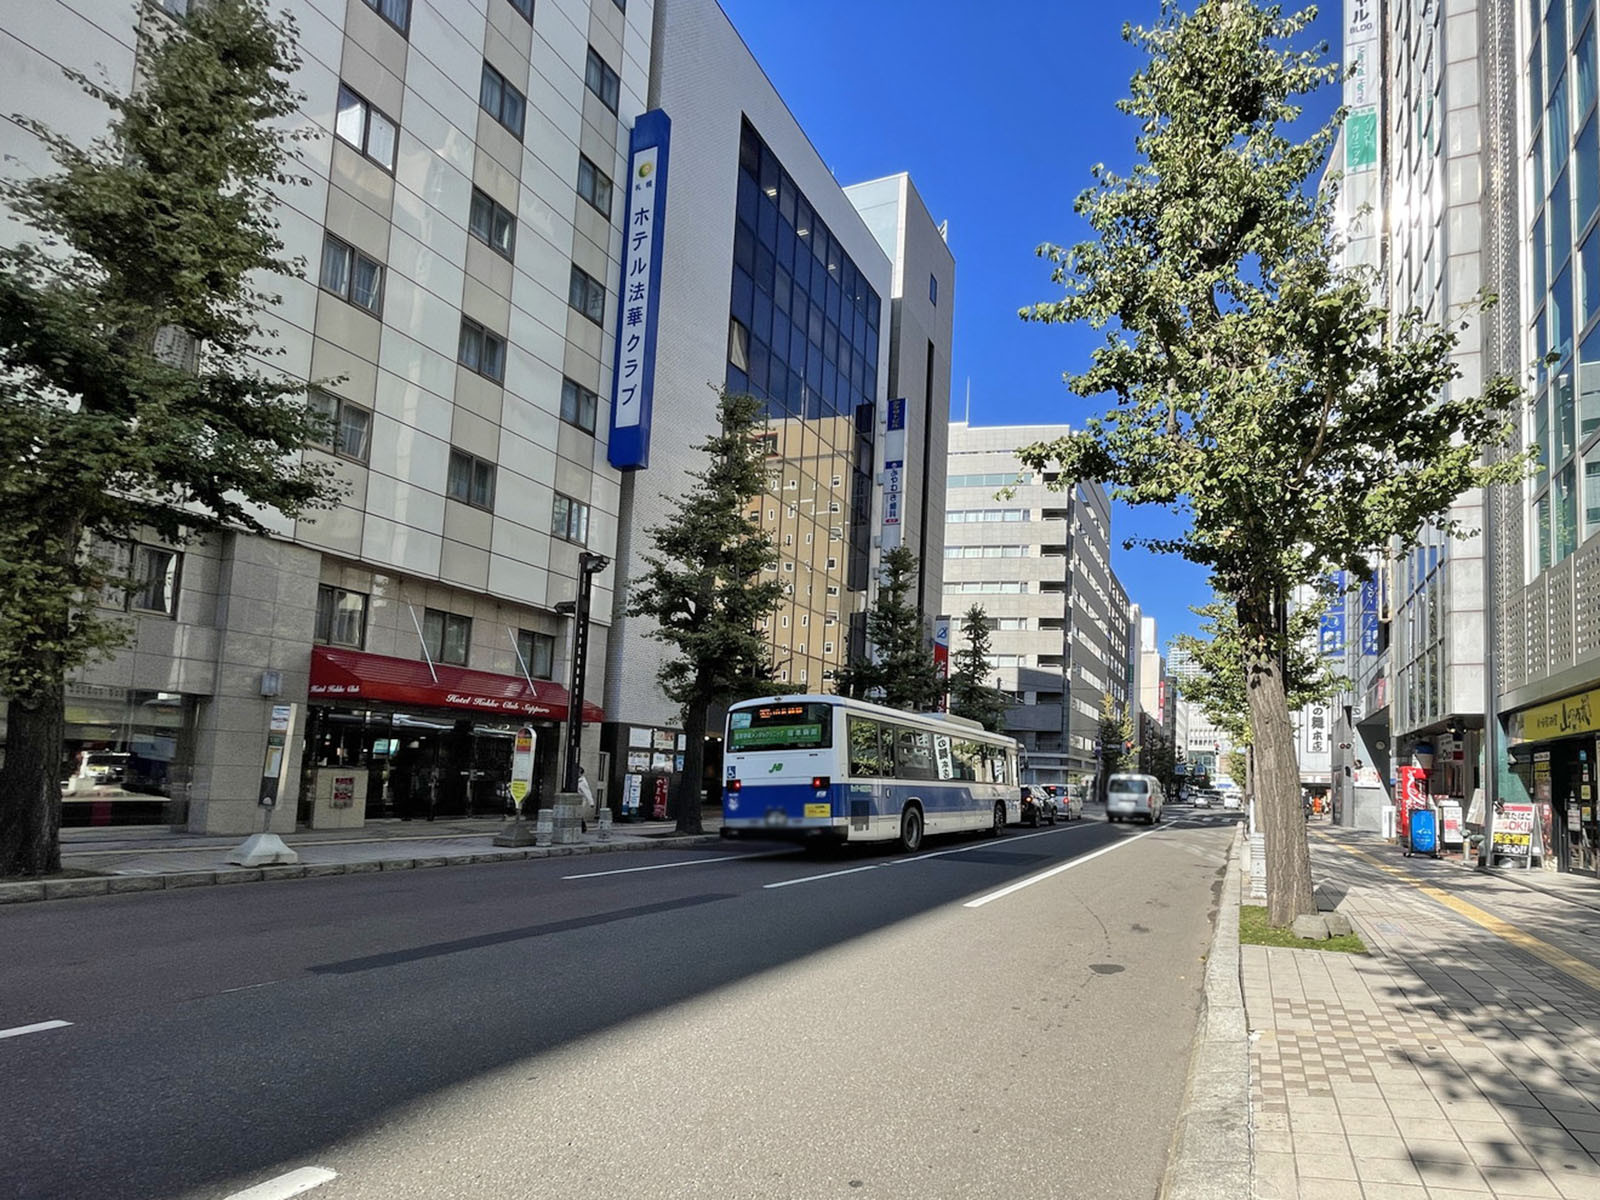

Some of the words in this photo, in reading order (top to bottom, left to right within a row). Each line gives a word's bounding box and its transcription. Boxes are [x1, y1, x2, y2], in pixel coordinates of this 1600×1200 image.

[1350, 22, 1372, 34] BLDG
[621, 207, 650, 406] ホテル法華クラブ
[445, 693, 471, 704] Hotel
[502, 701, 519, 710] Club
